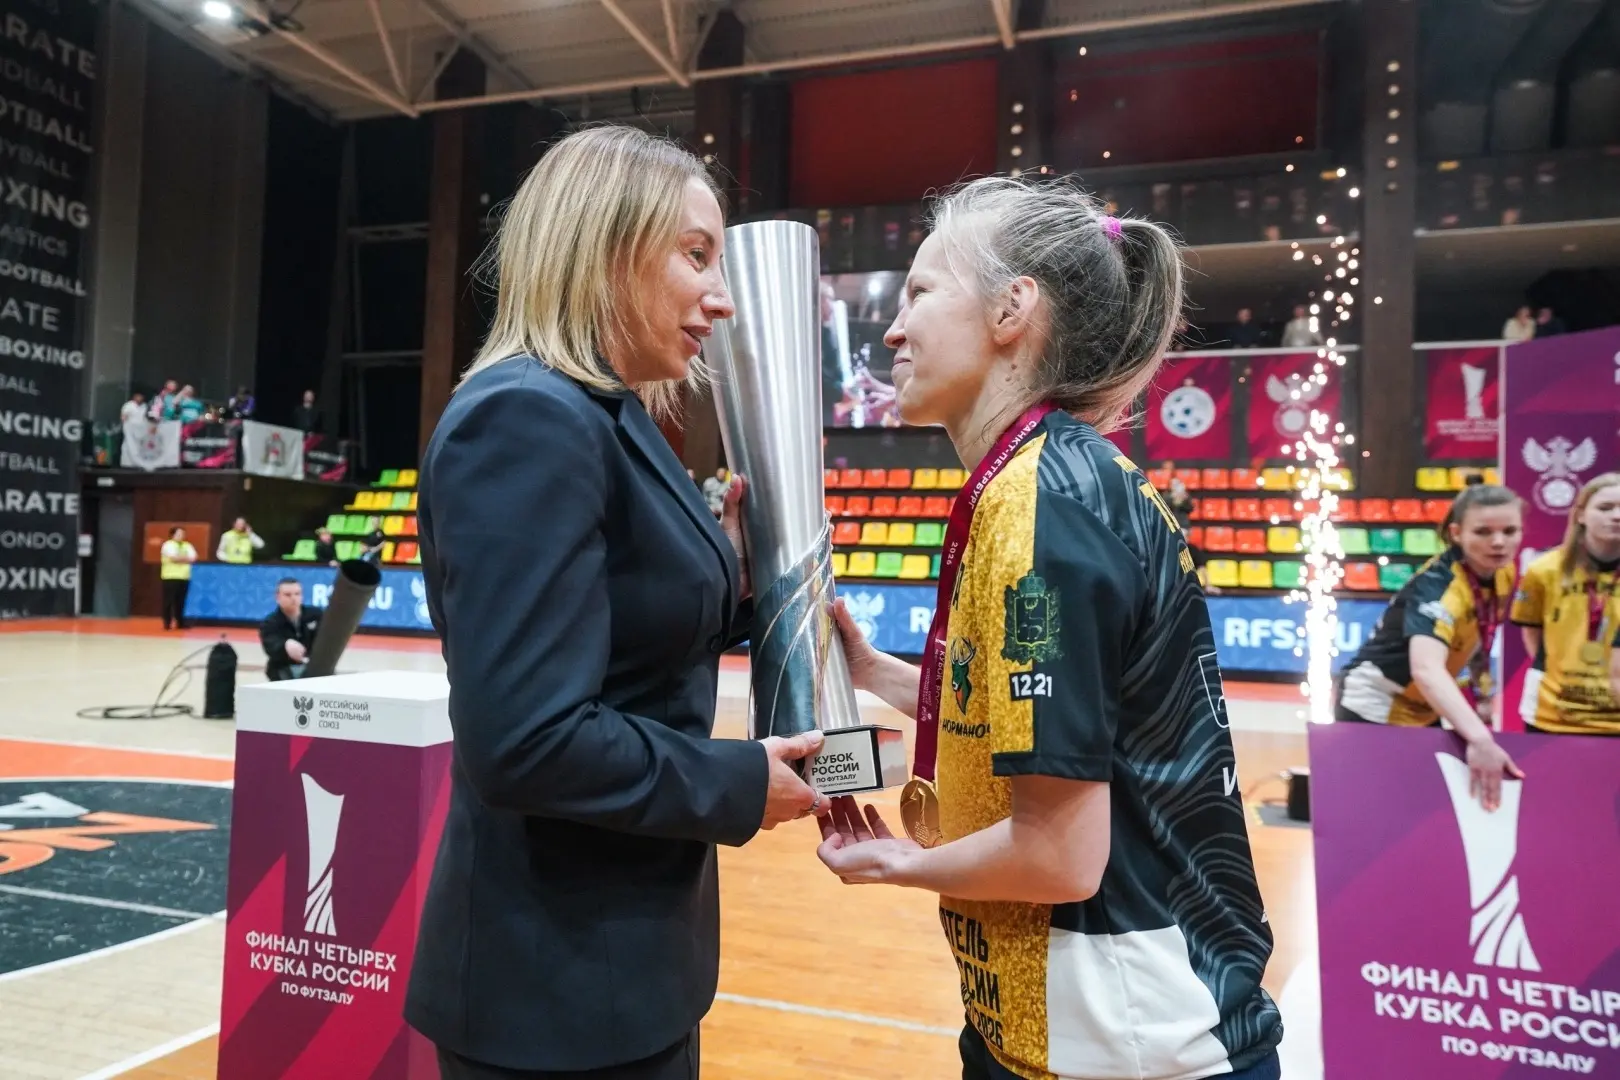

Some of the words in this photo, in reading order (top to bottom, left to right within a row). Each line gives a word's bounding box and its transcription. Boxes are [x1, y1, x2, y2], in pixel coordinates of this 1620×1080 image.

[0, 12, 96, 80] RATE
[0, 177, 91, 229] XING
[968, 420, 1037, 510] САНКТ-ПЕТЕРБУРГ
[0, 488, 79, 515] RATE
[0, 531, 65, 550] ONDO
[946, 541, 958, 566] 2026
[1224, 617, 1362, 652] RFS.U
[1011, 673, 1053, 698] 1221
[318, 710, 371, 722] ФУТБОЛЬНЫЙ
[319, 699, 369, 711] РОССИЙСКИЙ
[318, 720, 340, 730] СОЮЗ
[811, 762, 860, 776] РОССИИ
[814, 752, 854, 766] КУБОК
[827, 774, 857, 782] ФУТЗАЛУ
[245, 930, 309, 957] ФИНАЛ
[314, 941, 397, 972] ЧЕТЫРЕХ
[250, 952, 308, 978] КУБКА
[311, 962, 390, 993] РОССИИ
[1360, 961, 1489, 1000] ФИНАЛ
[281, 982, 298, 995] ПО
[300, 985, 354, 1005] ФУТЗАЛУ
[1374, 991, 1493, 1031] КУБКА
[1441, 1035, 1478, 1056] ПО
[1480, 1040, 1596, 1074] ФУТЗАЛУ
